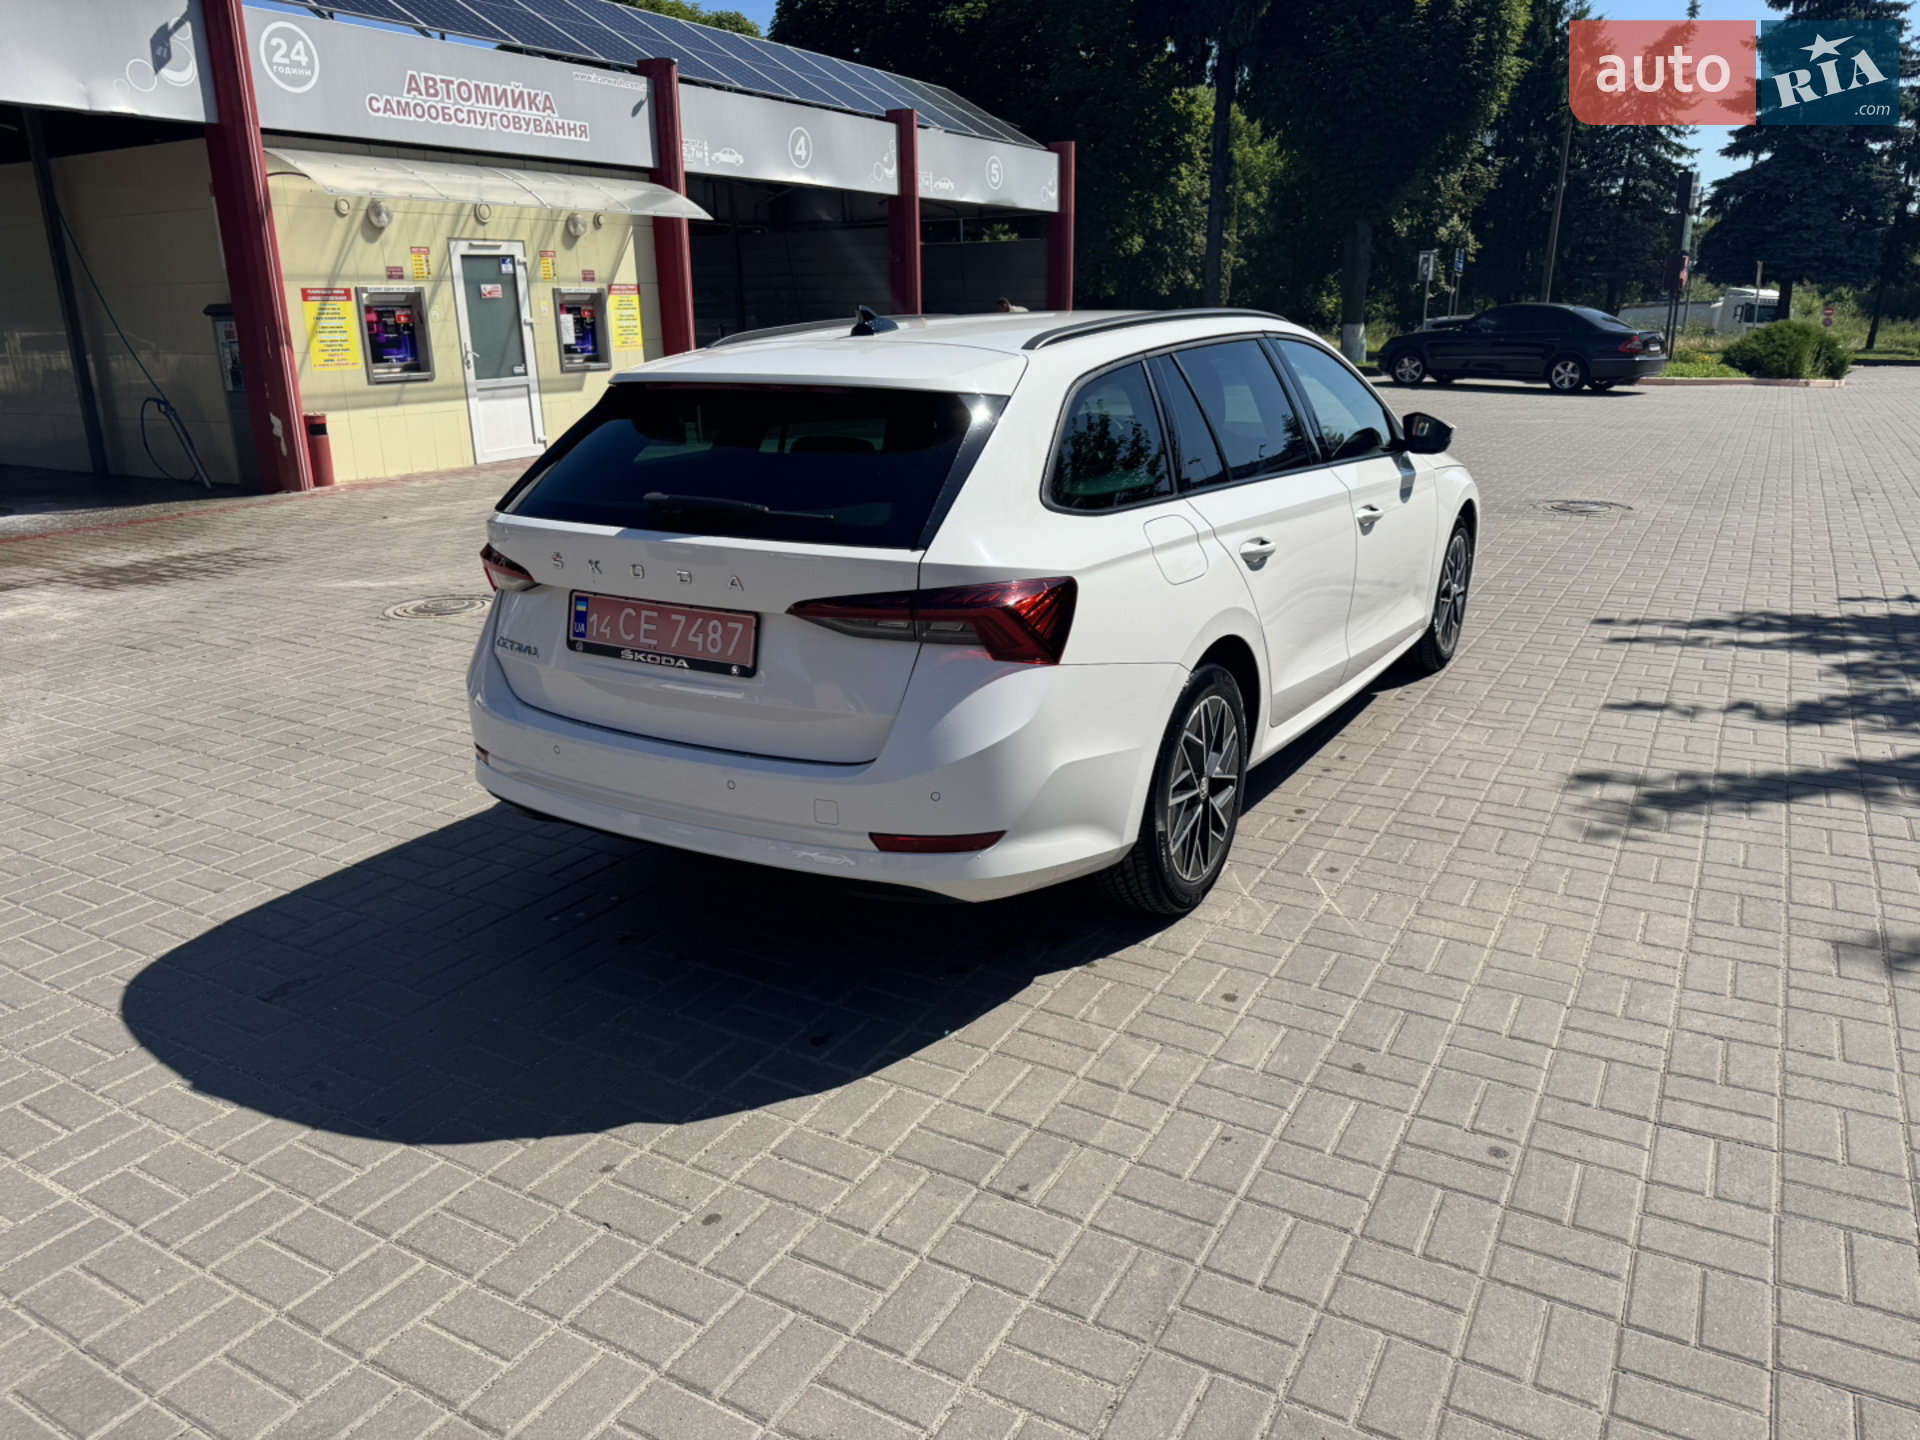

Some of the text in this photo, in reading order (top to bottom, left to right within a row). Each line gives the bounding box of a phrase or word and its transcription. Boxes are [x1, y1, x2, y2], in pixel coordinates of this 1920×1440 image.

[270, 37, 308, 66] 24
[404, 71, 557, 116] АВТОМИЙКА
[367, 94, 589, 140] САМООБСЛУГОВУВАННЯ
[795, 136, 807, 160] 4
[991, 163, 1000, 183] 5
[574, 621, 586, 634] UA
[589, 607, 744, 657] 14 CE 7487
[620, 649, 689, 669] ŠKODA
